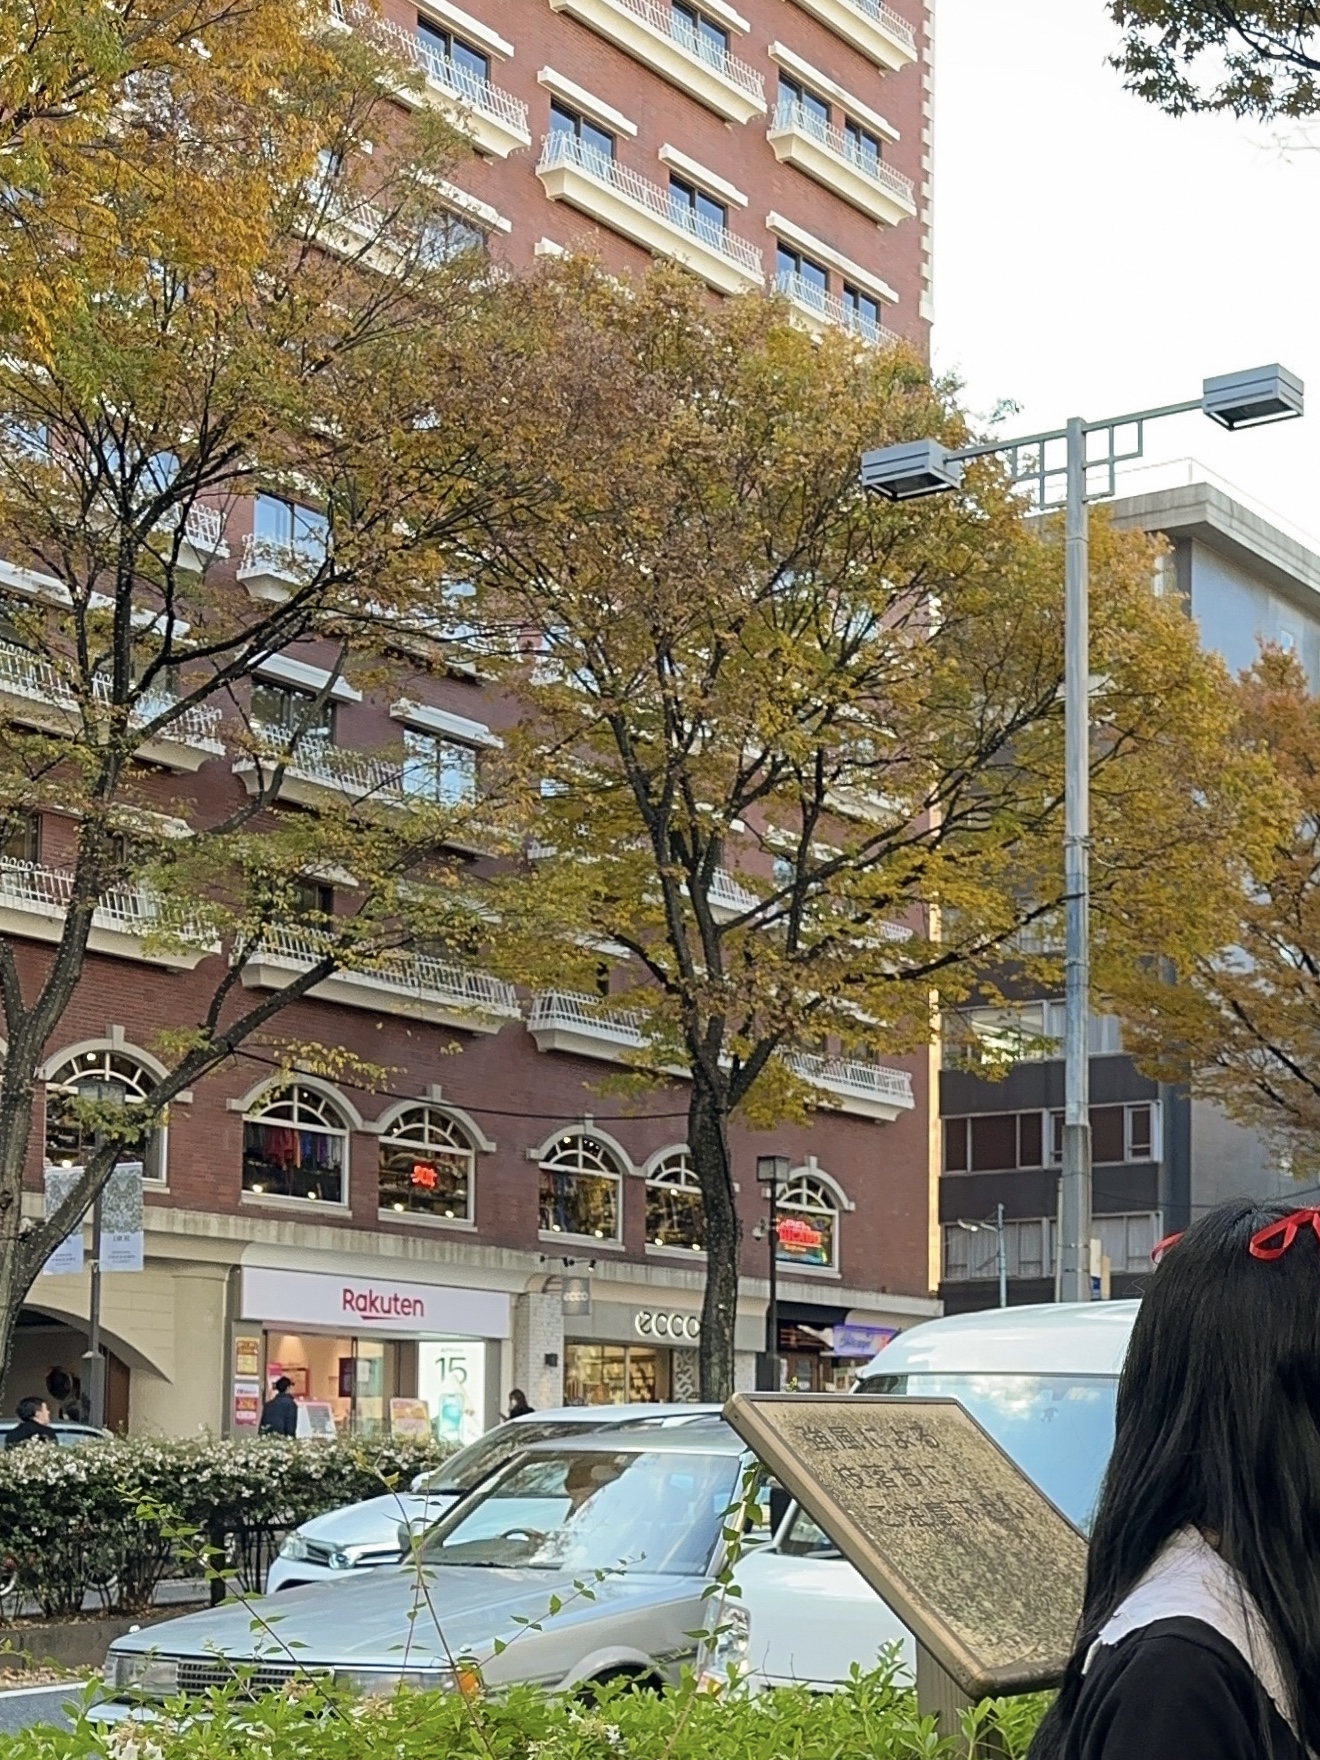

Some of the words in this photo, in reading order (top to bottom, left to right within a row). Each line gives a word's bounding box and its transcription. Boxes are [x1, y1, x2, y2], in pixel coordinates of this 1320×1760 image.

[342, 1288, 424, 1318] Rakuten
[635, 1310, 701, 1341] ecco
[435, 1356, 468, 1385] 15
[797, 1422, 940, 1451] 強風による
[832, 1461, 950, 1490] 枝落ちに
